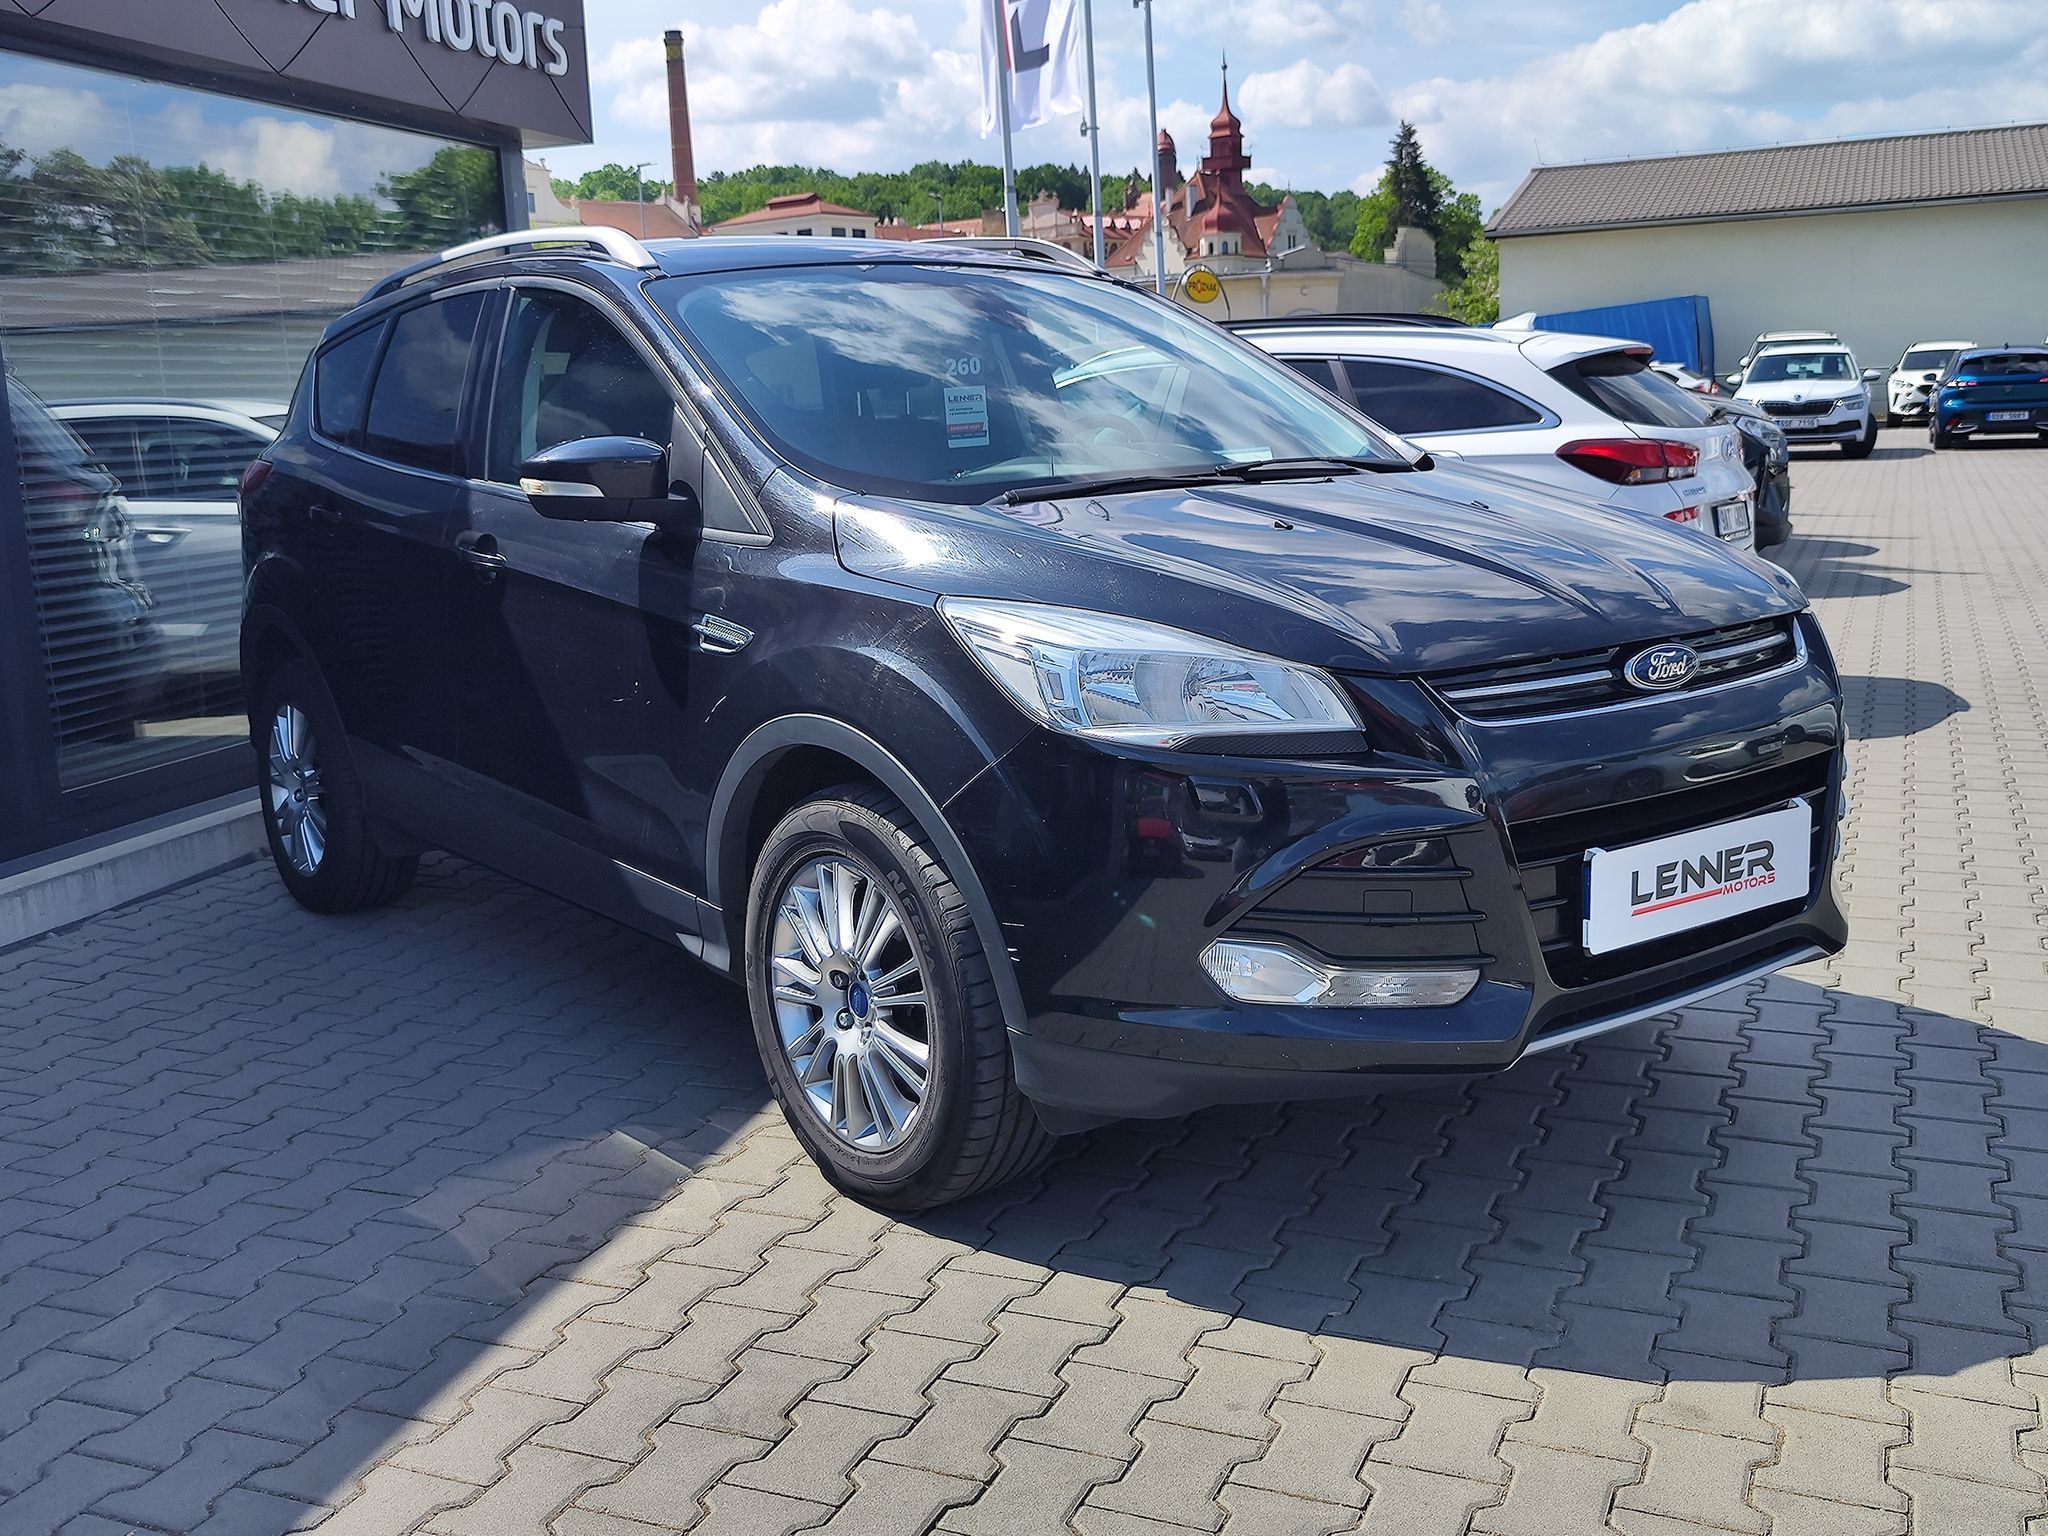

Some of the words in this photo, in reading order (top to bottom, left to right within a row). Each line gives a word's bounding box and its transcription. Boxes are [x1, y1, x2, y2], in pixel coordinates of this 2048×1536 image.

[946, 356, 981, 376] 260
[948, 394, 983, 402] LENNER
[1648, 650, 1688, 681] Ford
[1631, 840, 1776, 906] LENNER
[1723, 872, 1776, 895] MOTORS
